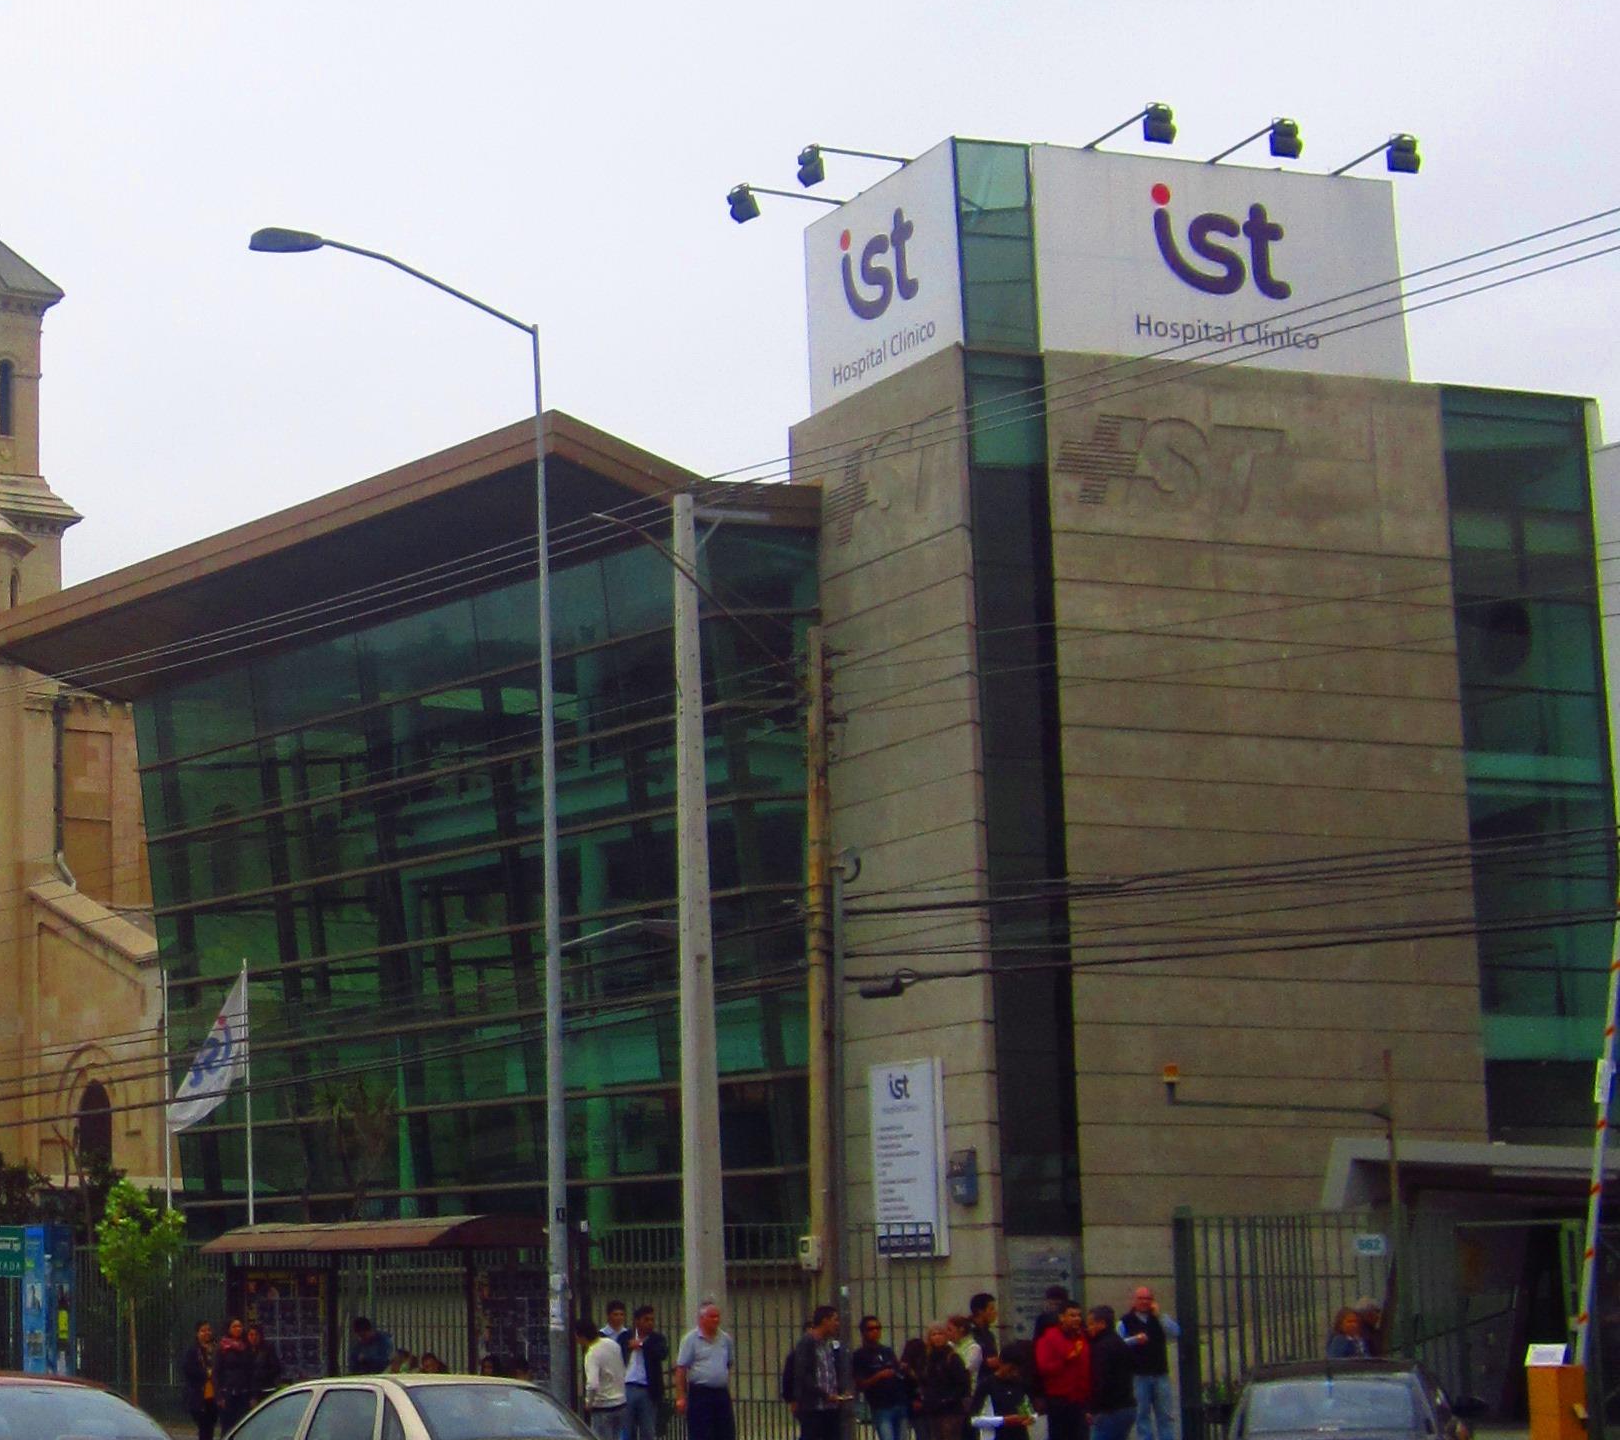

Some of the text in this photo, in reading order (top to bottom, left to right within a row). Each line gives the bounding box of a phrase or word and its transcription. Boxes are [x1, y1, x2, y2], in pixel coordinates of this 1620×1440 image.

[839, 208, 919, 320] ist
[1151, 183, 1292, 300] ist
[833, 319, 936, 388] Hospital Clínico
[1135, 313, 1319, 350] Hospital Clínico
[888, 1073, 910, 1100] ist
